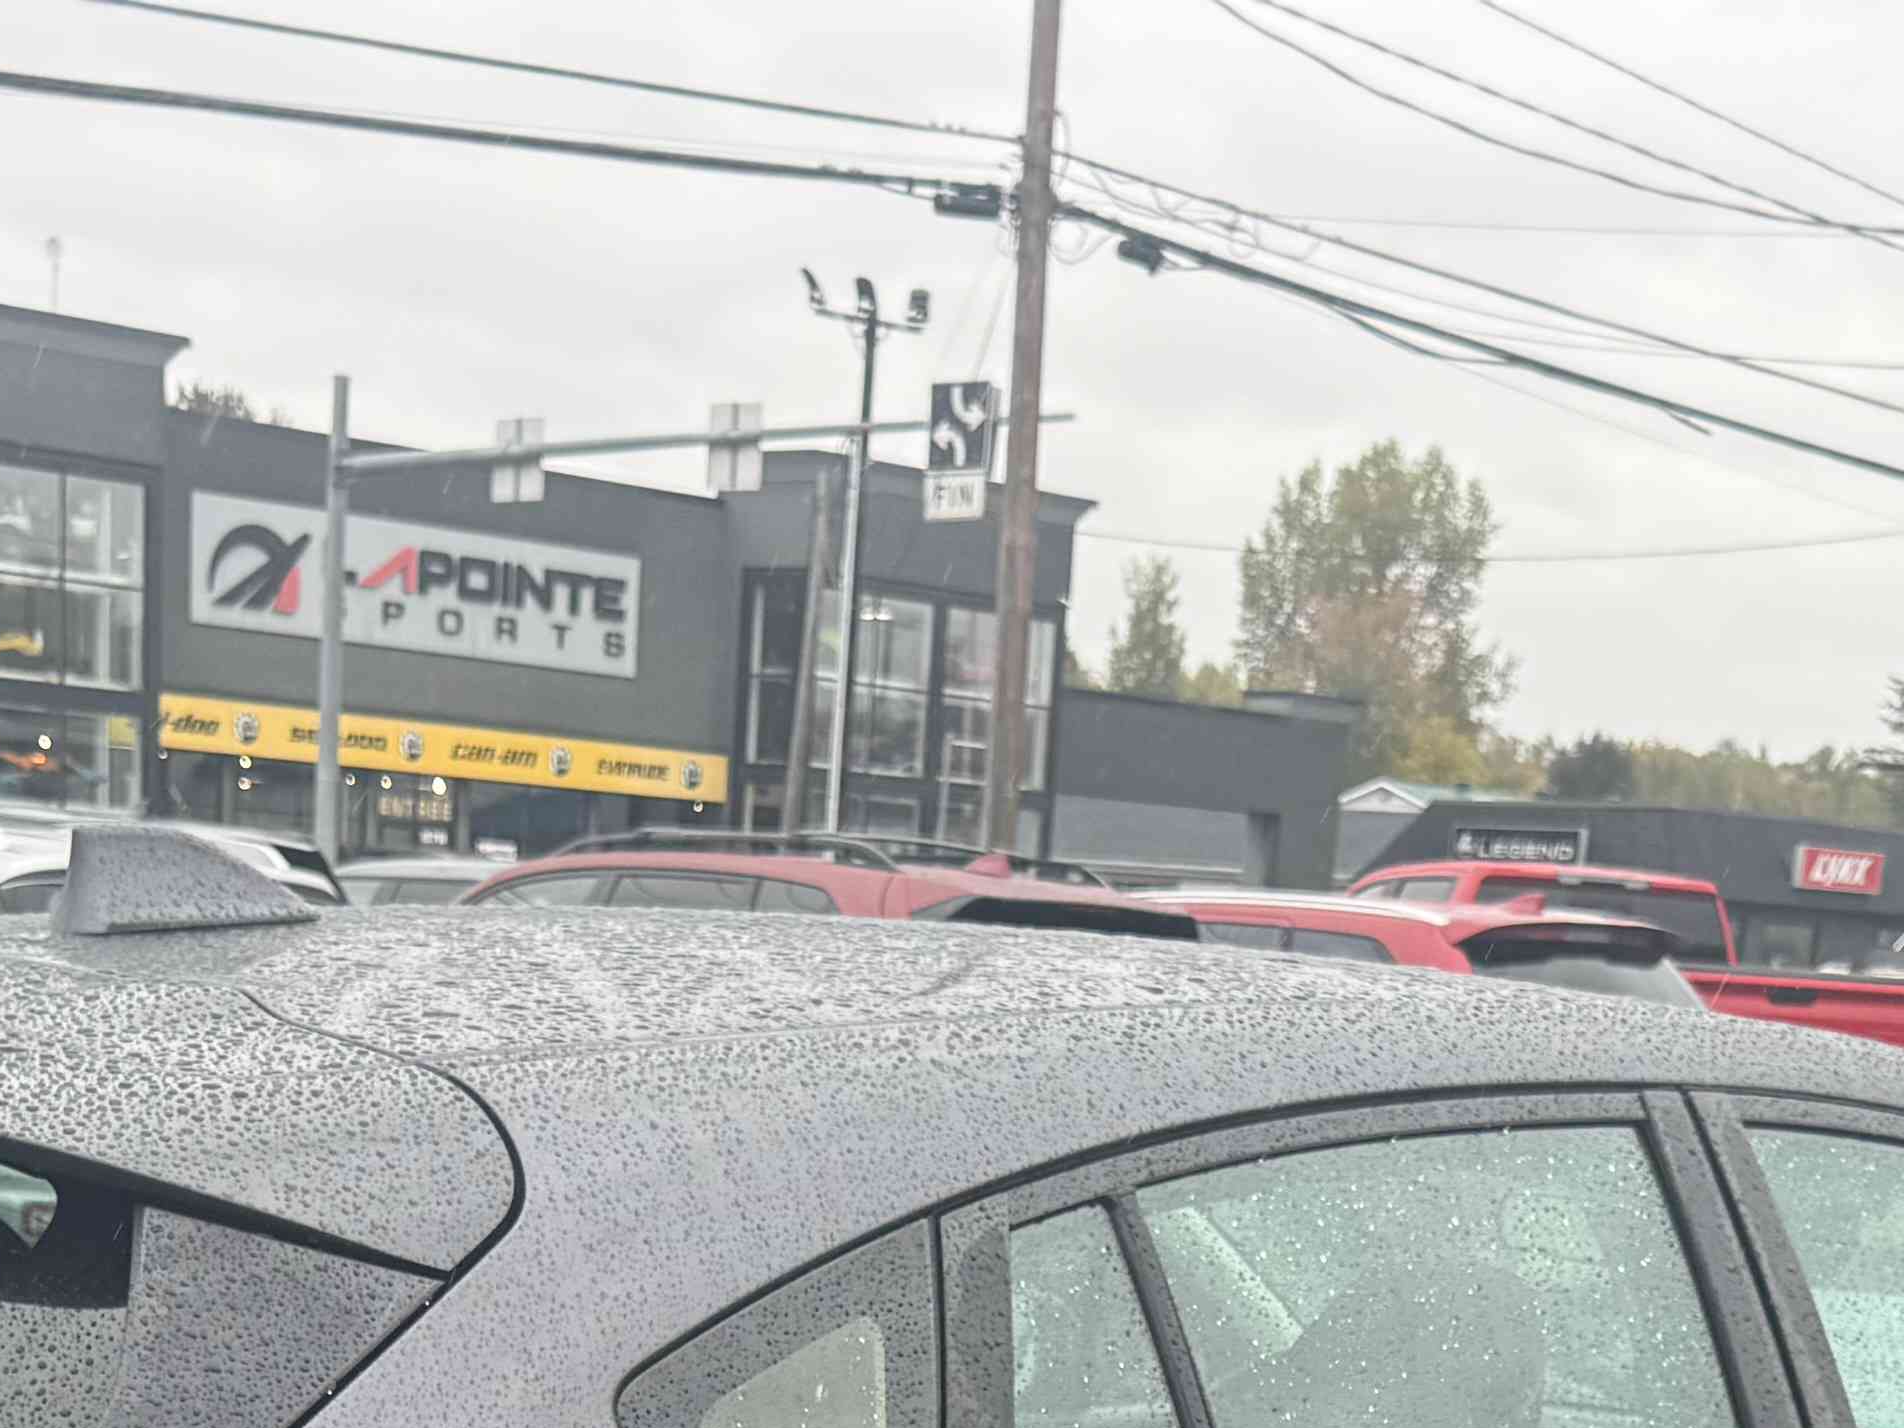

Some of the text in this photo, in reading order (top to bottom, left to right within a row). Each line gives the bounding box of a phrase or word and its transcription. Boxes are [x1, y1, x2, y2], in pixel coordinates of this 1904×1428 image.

[345, 546, 627, 623] APOINTE
[380, 599, 626, 658] PORTS
[1478, 837, 1576, 862] LEGEND
